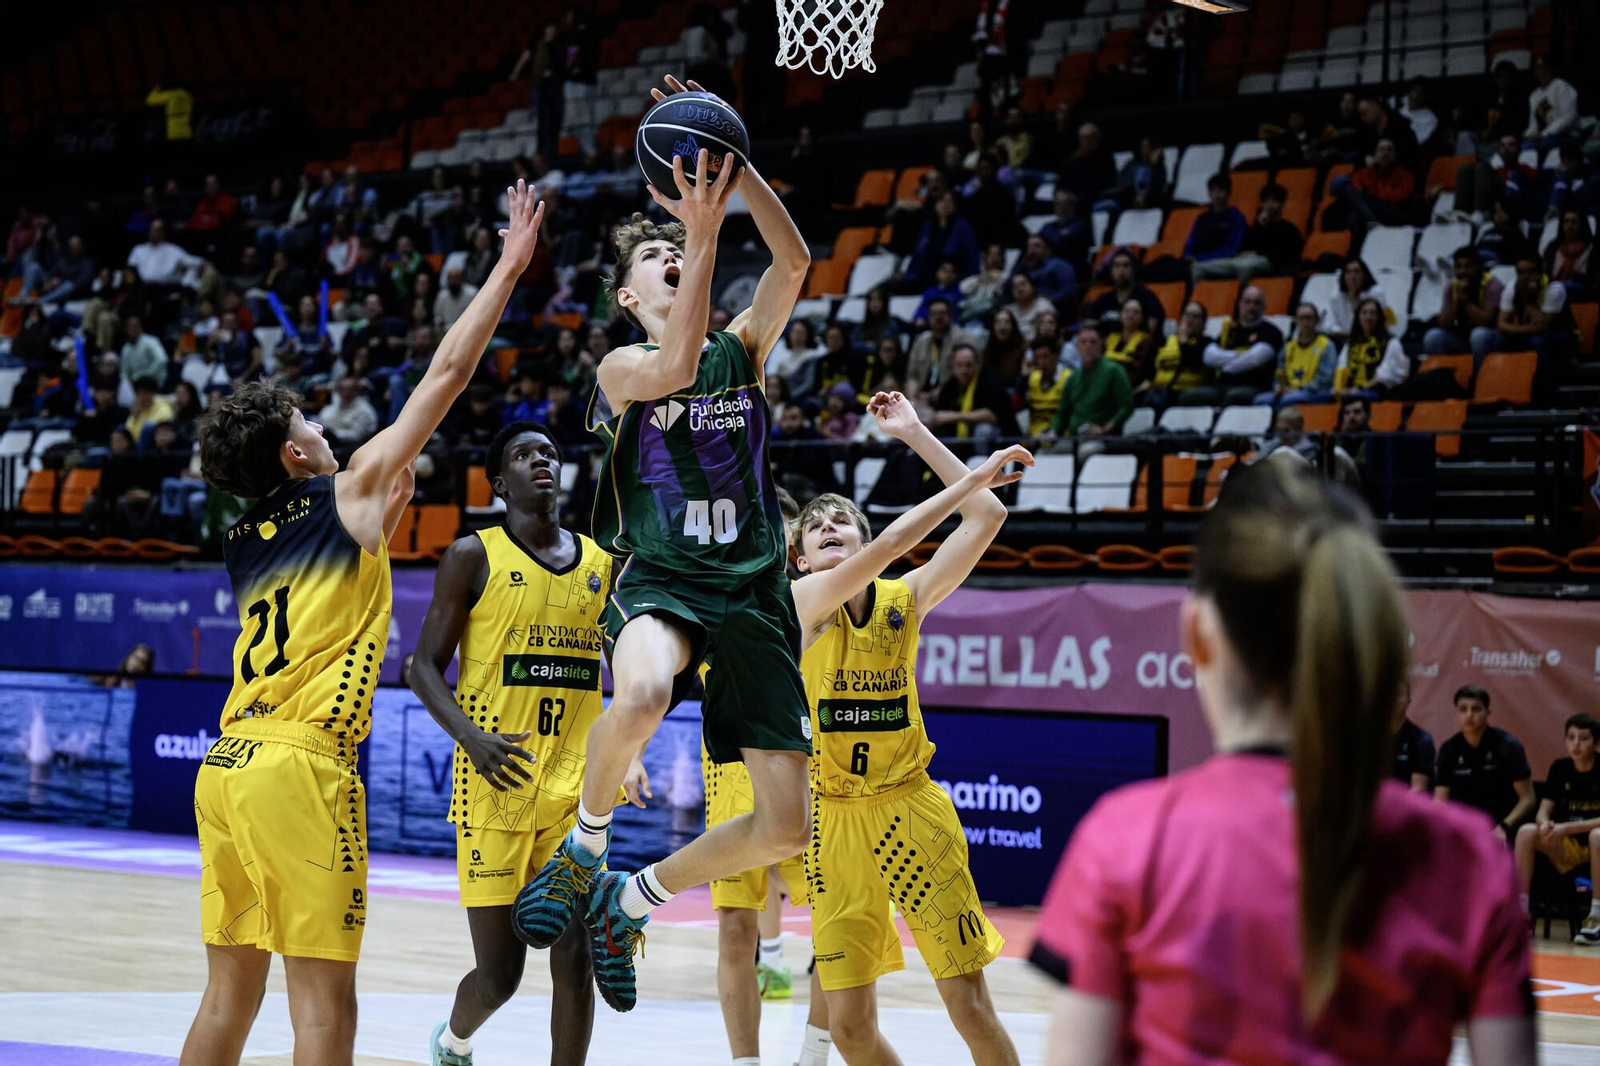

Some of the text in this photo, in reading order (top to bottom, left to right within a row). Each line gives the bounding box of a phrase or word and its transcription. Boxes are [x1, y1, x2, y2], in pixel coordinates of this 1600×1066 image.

[690, 413, 746, 432] Unicaja
[287, 509, 310, 523] ISLAS
[683, 498, 739, 545] 40
[528, 636, 544, 647] CB
[529, 624, 602, 641] FUNDACIÓN
[919, 634, 1112, 690] RELLAS
[833, 675, 908, 692] CB CANARIS
[537, 697, 566, 737] 62
[850, 742, 870, 776] 6
[988, 826, 1043, 850] travel
